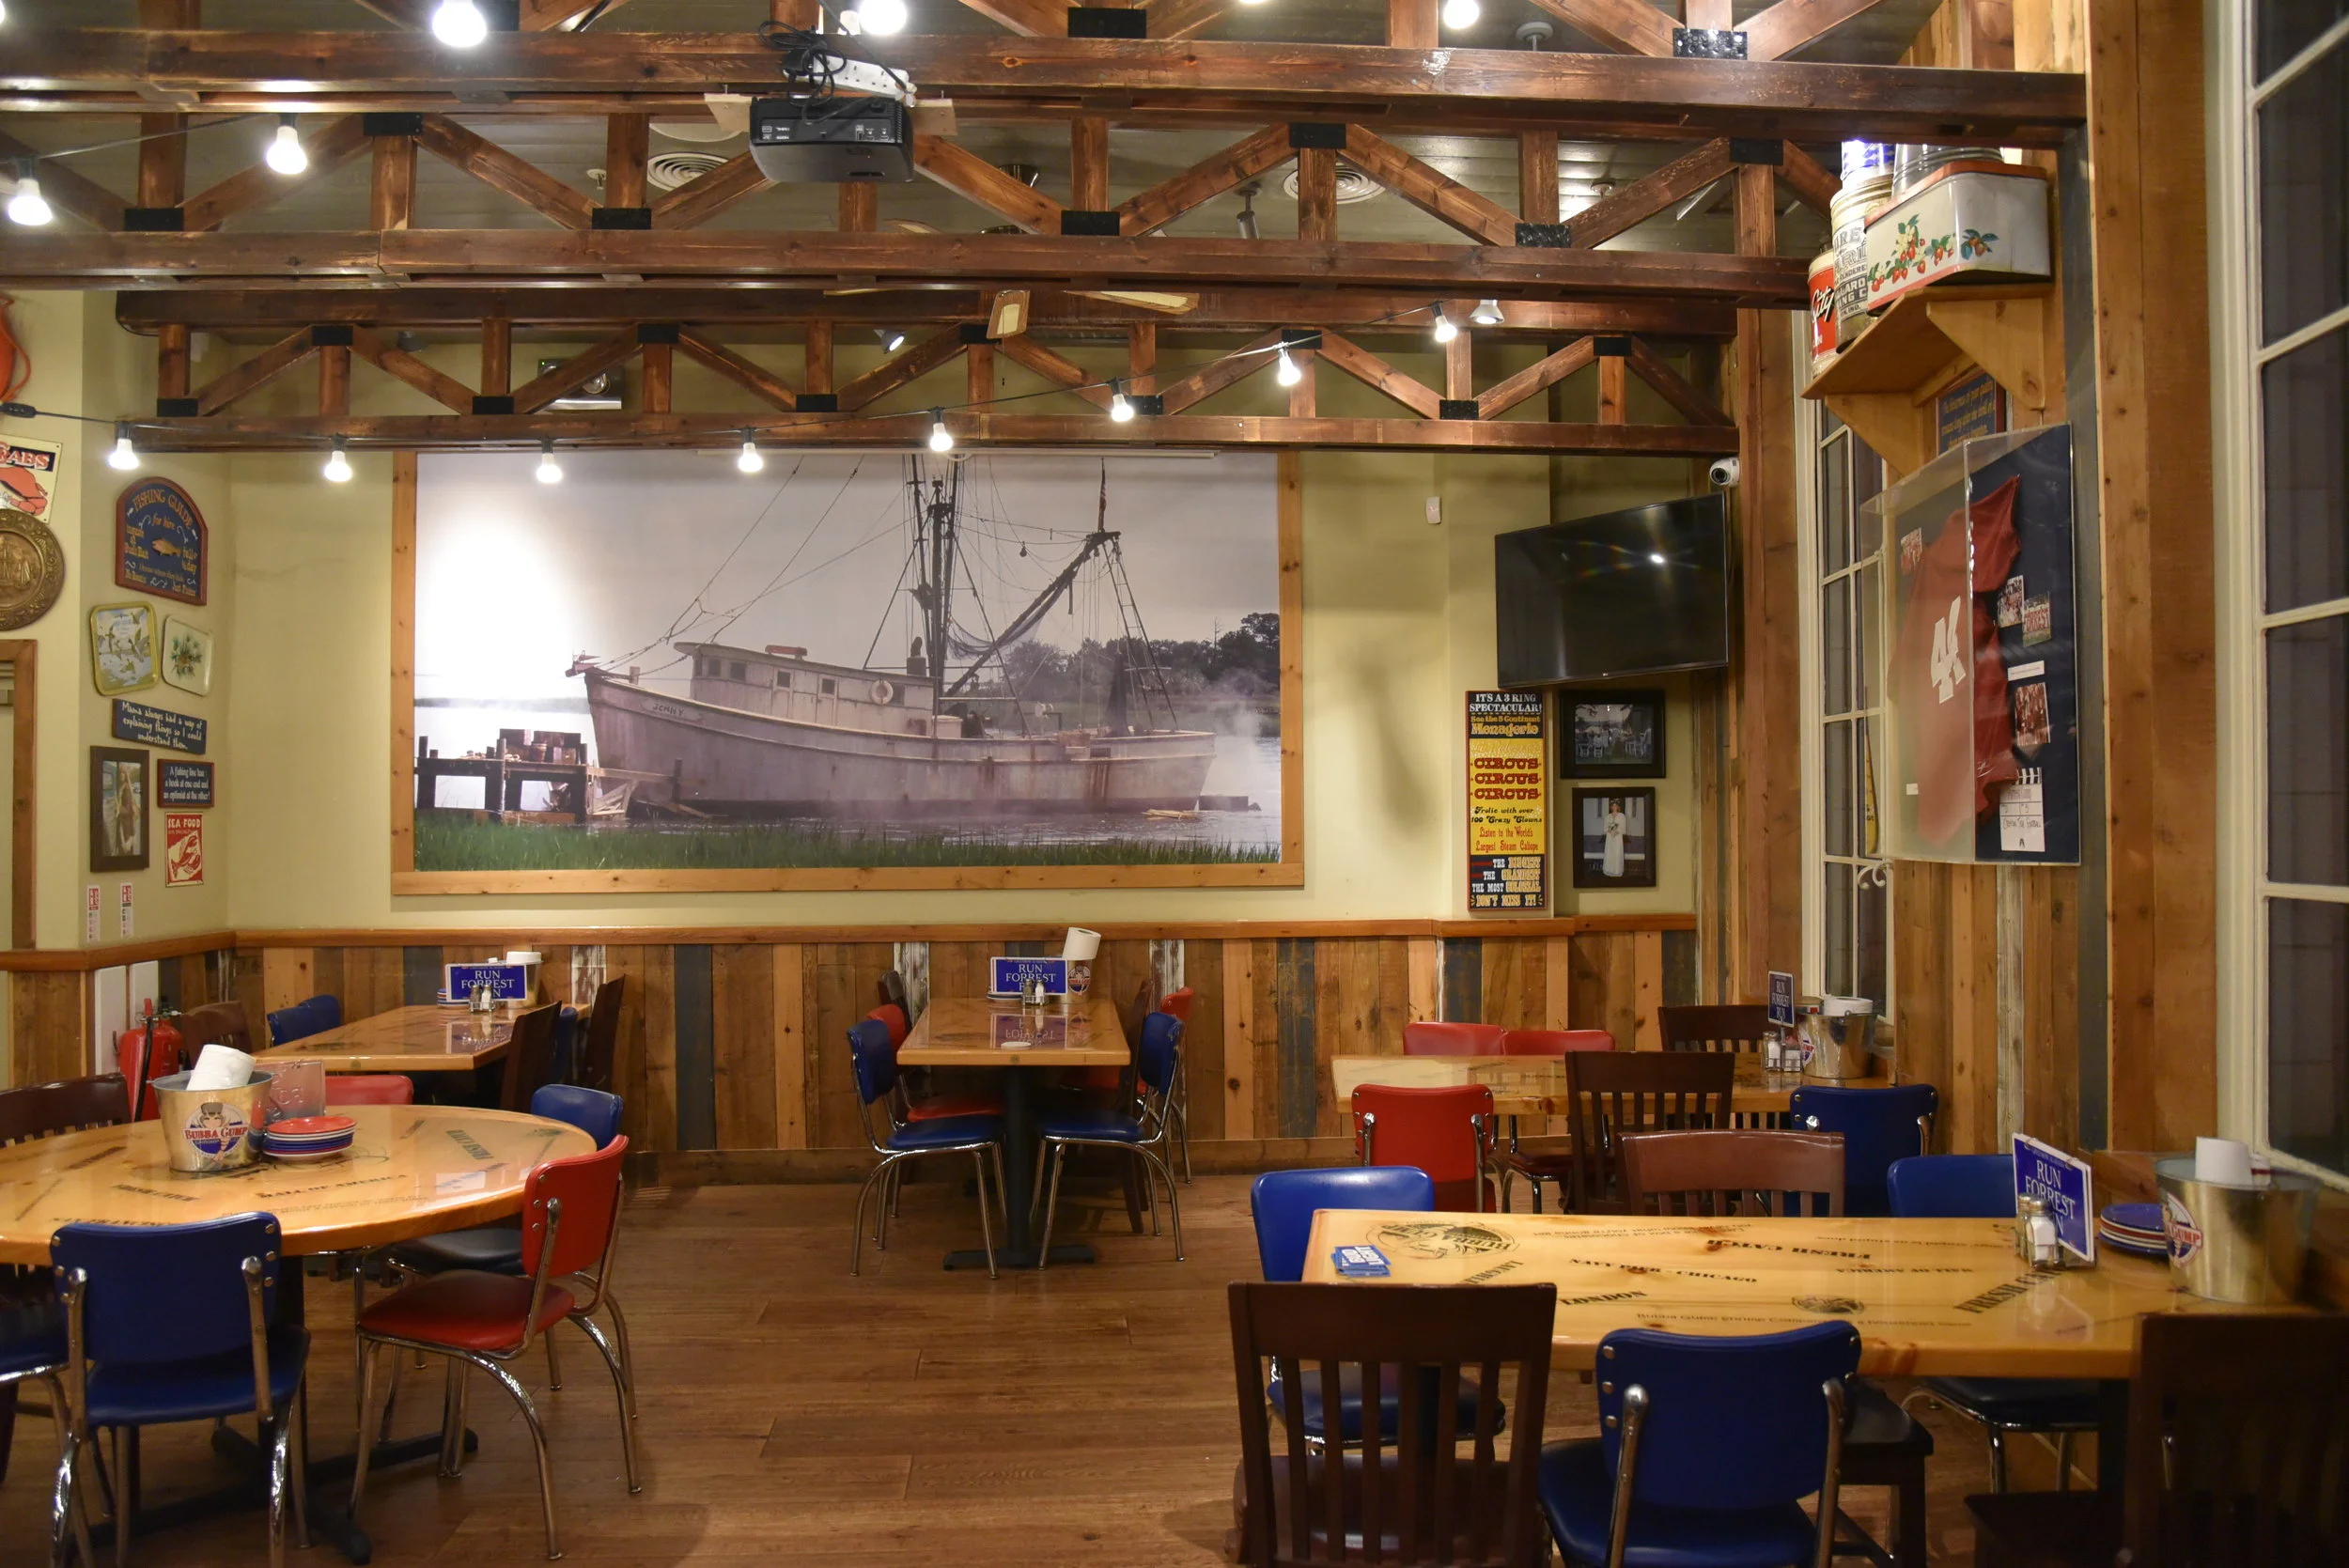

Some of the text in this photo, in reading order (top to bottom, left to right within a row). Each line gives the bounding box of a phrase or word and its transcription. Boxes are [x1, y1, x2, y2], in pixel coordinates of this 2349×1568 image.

[132, 489, 194, 529] FISHING GUIDE
[151, 512, 176, 530] for hire
[1931, 596, 1966, 704] 44
[1494, 693, 1502, 702] A
[1503, 693, 1510, 703] 3
[1512, 693, 1536, 703] RING
[1470, 703, 1542, 712] SPECTACULAR!
[122, 702, 143, 716] Mama
[145, 708, 163, 722] always
[165, 713, 177, 723] had
[184, 720, 194, 731] way
[196, 721, 203, 730] of
[1486, 714, 1498, 722] the
[122, 715, 152, 734] explaining
[155, 720, 172, 737] things
[187, 730, 202, 741] could
[1470, 722, 1539, 737] Menagerie
[137, 730, 171, 747] understand
[1474, 757, 1539, 769] CIRCUS
[170, 766, 174, 775] A
[174, 766, 188, 779] fishing
[1474, 772, 1539, 784] CIRCUS
[169, 778, 179, 789] hook
[180, 779, 184, 788] at
[169, 790, 186, 802] optimist
[1474, 787, 1540, 800] CIRCUS
[1474, 806, 1498, 815] Frolic
[168, 818, 201, 829] SEA FOOD
[1486, 815, 1511, 824] Crazy
[1479, 827, 1496, 837] Listen
[1498, 829, 1503, 837] to
[1505, 828, 1514, 837] the
[1475, 840, 1496, 853] Largest
[1500, 840, 1517, 850] Steam
[1493, 857, 1541, 868] THE BIGGEST
[1484, 868, 1541, 881] THE GRANDEST
[1472, 880, 1541, 893] THE MOST COLOSSAL
[1476, 893, 1536, 907] DON'T MISS IT!
[474, 970, 501, 979] RUN
[1019, 964, 1043, 973] RUN
[461, 979, 515, 989] FORREST
[1005, 972, 1056, 983] FORREST
[1776, 981, 1785, 993] RUN
[1771, 992, 1789, 1008] FORREST
[185, 1126, 248, 1141] BUBBA GUMP
[2036, 1159, 2061, 1190] RUN
[2025, 1174, 2076, 1219] FORREST
[1569, 1259, 1613, 1267] NAVY
[1620, 1264, 1661, 1272] PIER
[1676, 1271, 1757, 1282] CHICAGO
[1561, 1291, 1648, 1305] LONDON
[1954, 1283, 2028, 1313] FRESH
